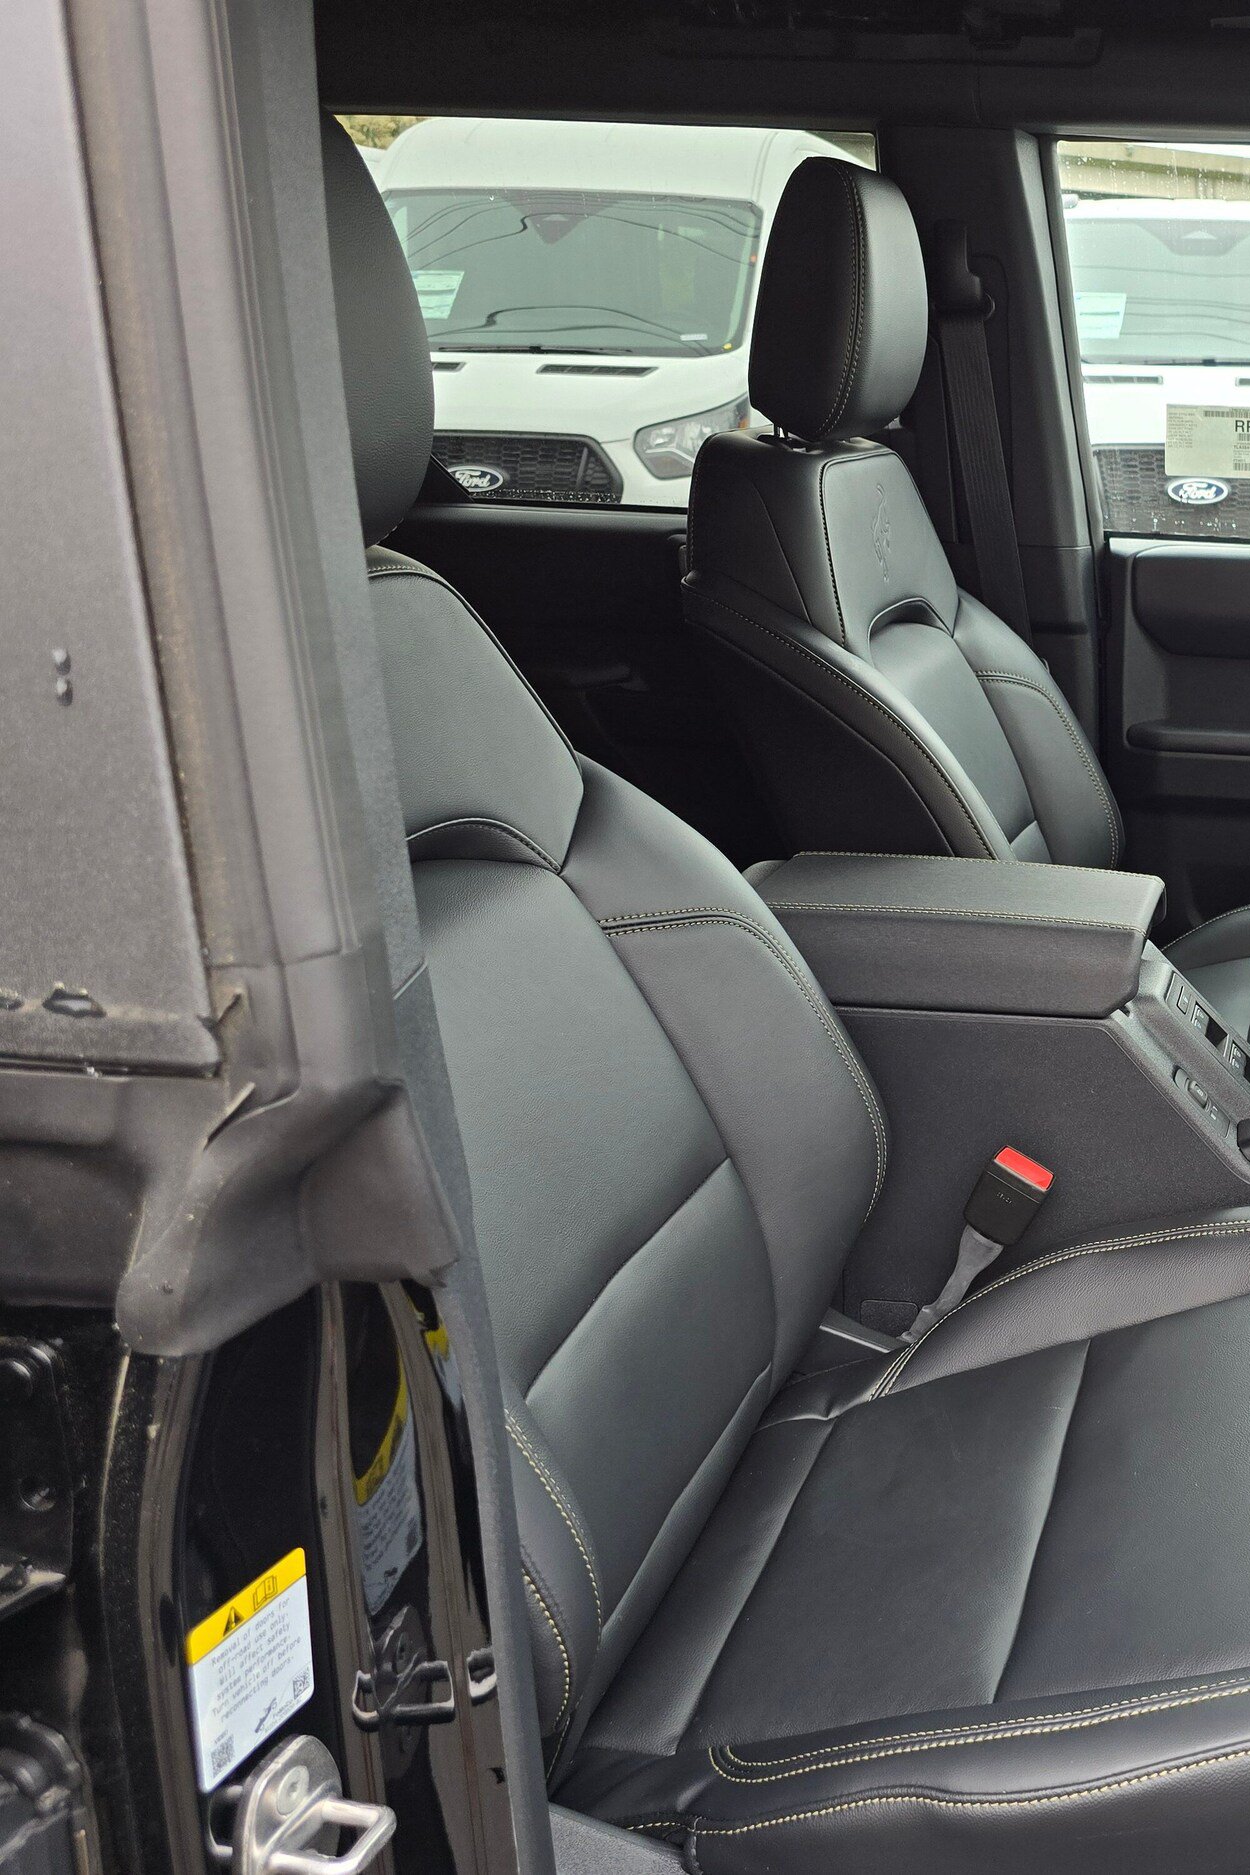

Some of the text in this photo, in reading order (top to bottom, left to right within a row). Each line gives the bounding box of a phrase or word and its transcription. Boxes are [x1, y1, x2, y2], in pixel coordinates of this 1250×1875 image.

[455, 470, 491, 488] Ford
[1178, 482, 1217, 499] Ford
[211, 1597, 290, 1667] Removal of doors for
[217, 1612, 289, 1675] off-road use only.
[239, 1643, 263, 1669] affect
[266, 1622, 290, 1646] safety
[212, 1636, 301, 1717] Turn vehicle off before
[216, 1635, 291, 1701] system performance.
[220, 1676, 268, 1723] reconnecting
[271, 1656, 294, 1678] doors.
